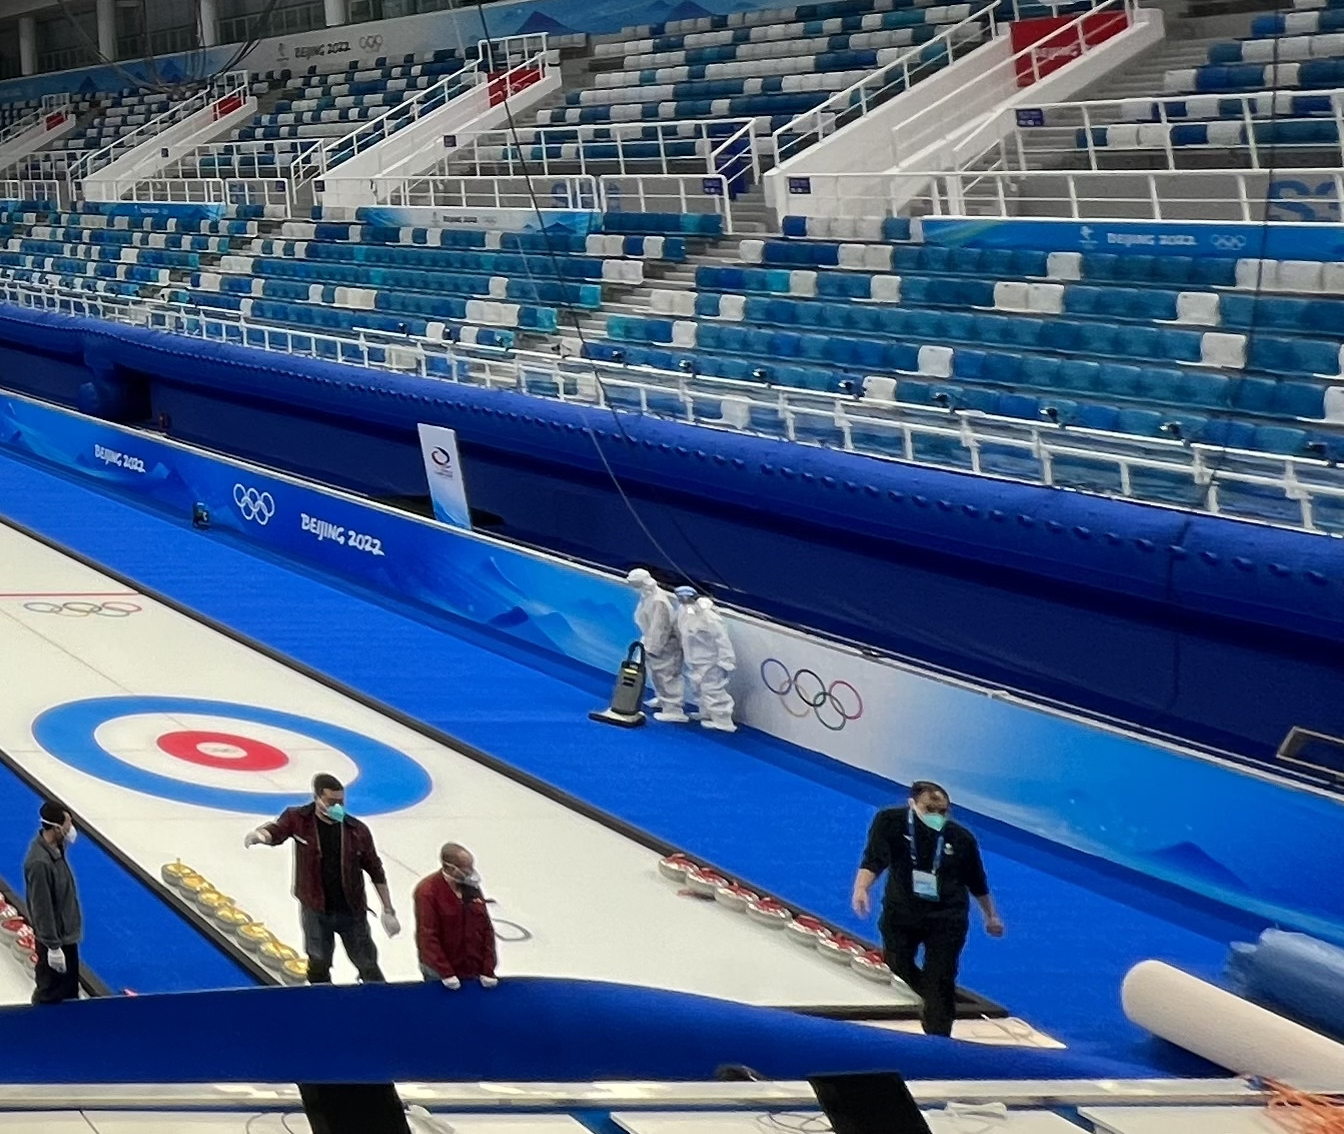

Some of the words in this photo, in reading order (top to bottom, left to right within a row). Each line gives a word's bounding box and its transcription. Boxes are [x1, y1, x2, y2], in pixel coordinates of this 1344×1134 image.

[294, 43, 325, 60] BEIJING
[327, 41, 351, 55] 2022
[94, 443, 122, 467] BEIJING
[122, 454, 147, 473] 2022
[300, 512, 346, 545] BEIJING
[347, 530, 386, 556] 2022
